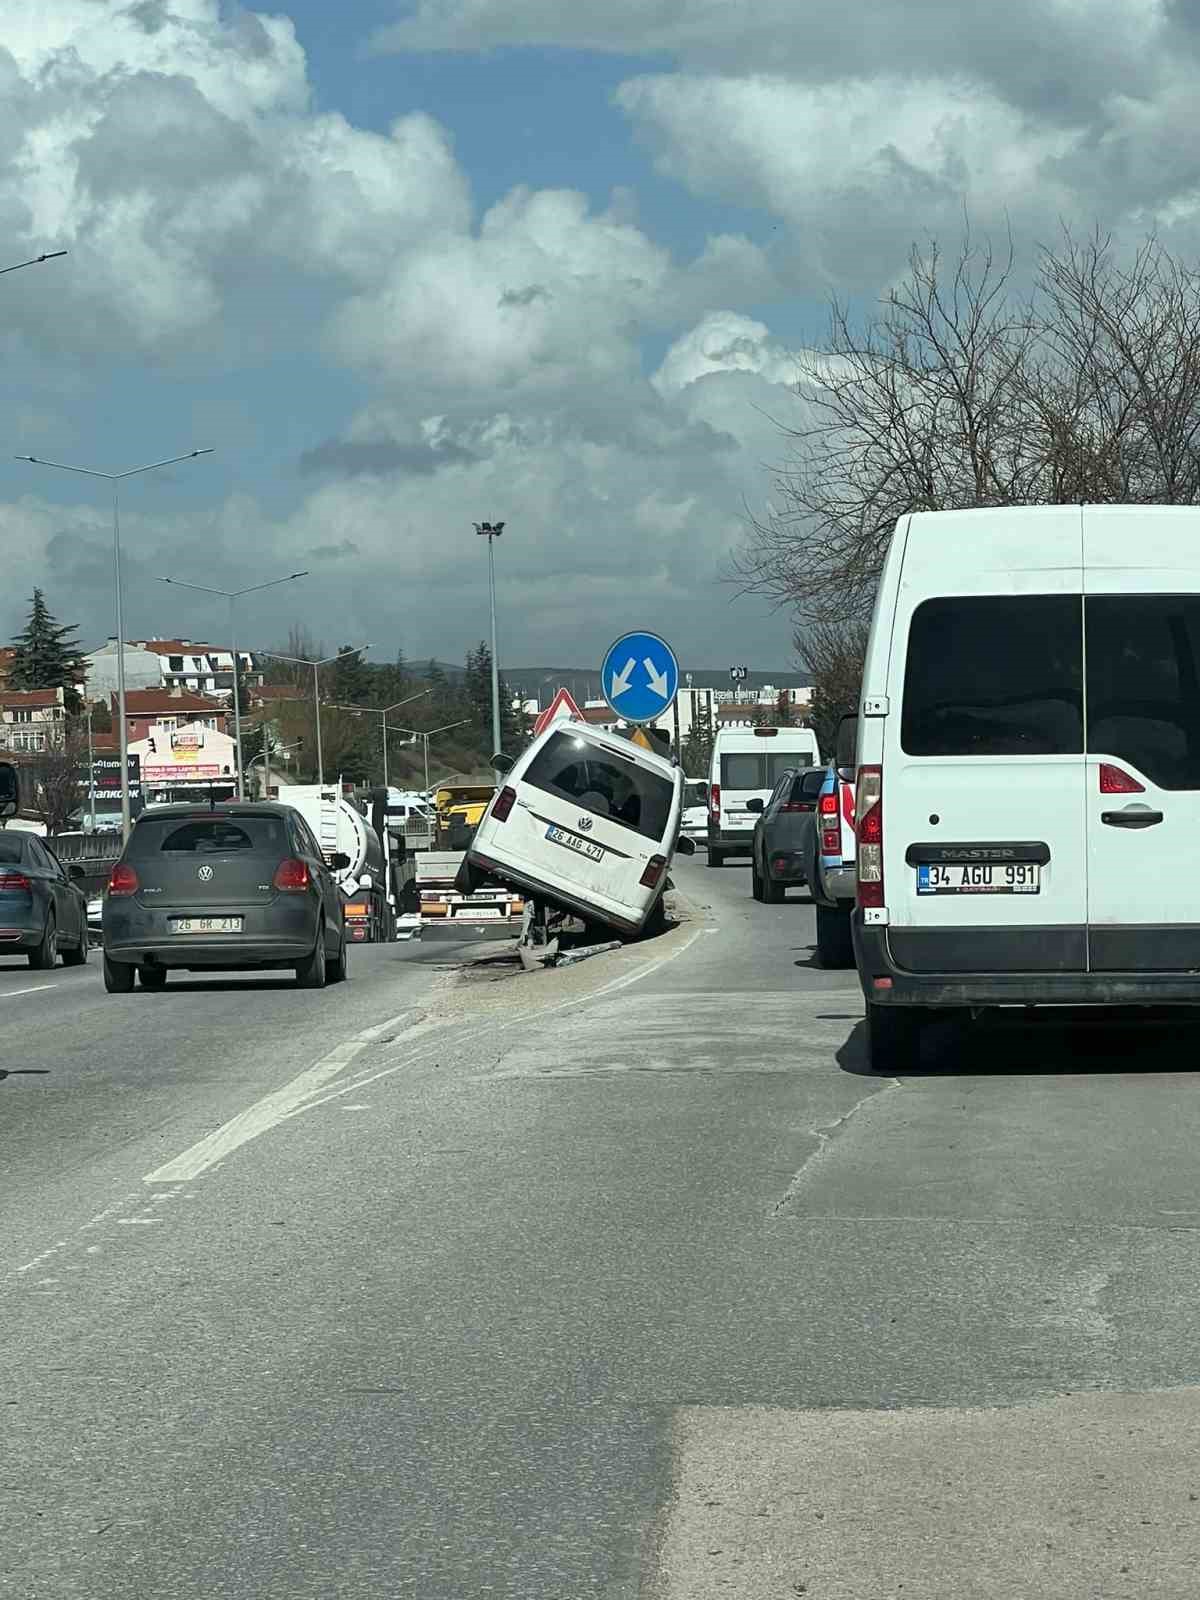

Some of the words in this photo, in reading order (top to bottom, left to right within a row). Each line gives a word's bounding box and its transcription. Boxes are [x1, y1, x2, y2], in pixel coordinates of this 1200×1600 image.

[553, 830, 563, 840] 26
[586, 845, 601, 857] 471
[941, 849, 1015, 858] MASTER
[930, 866, 950, 885] 34
[961, 866, 992, 885] AGU
[1005, 866, 1035, 885] 991
[179, 919, 191, 929] 26
[221, 919, 240, 929] 213
